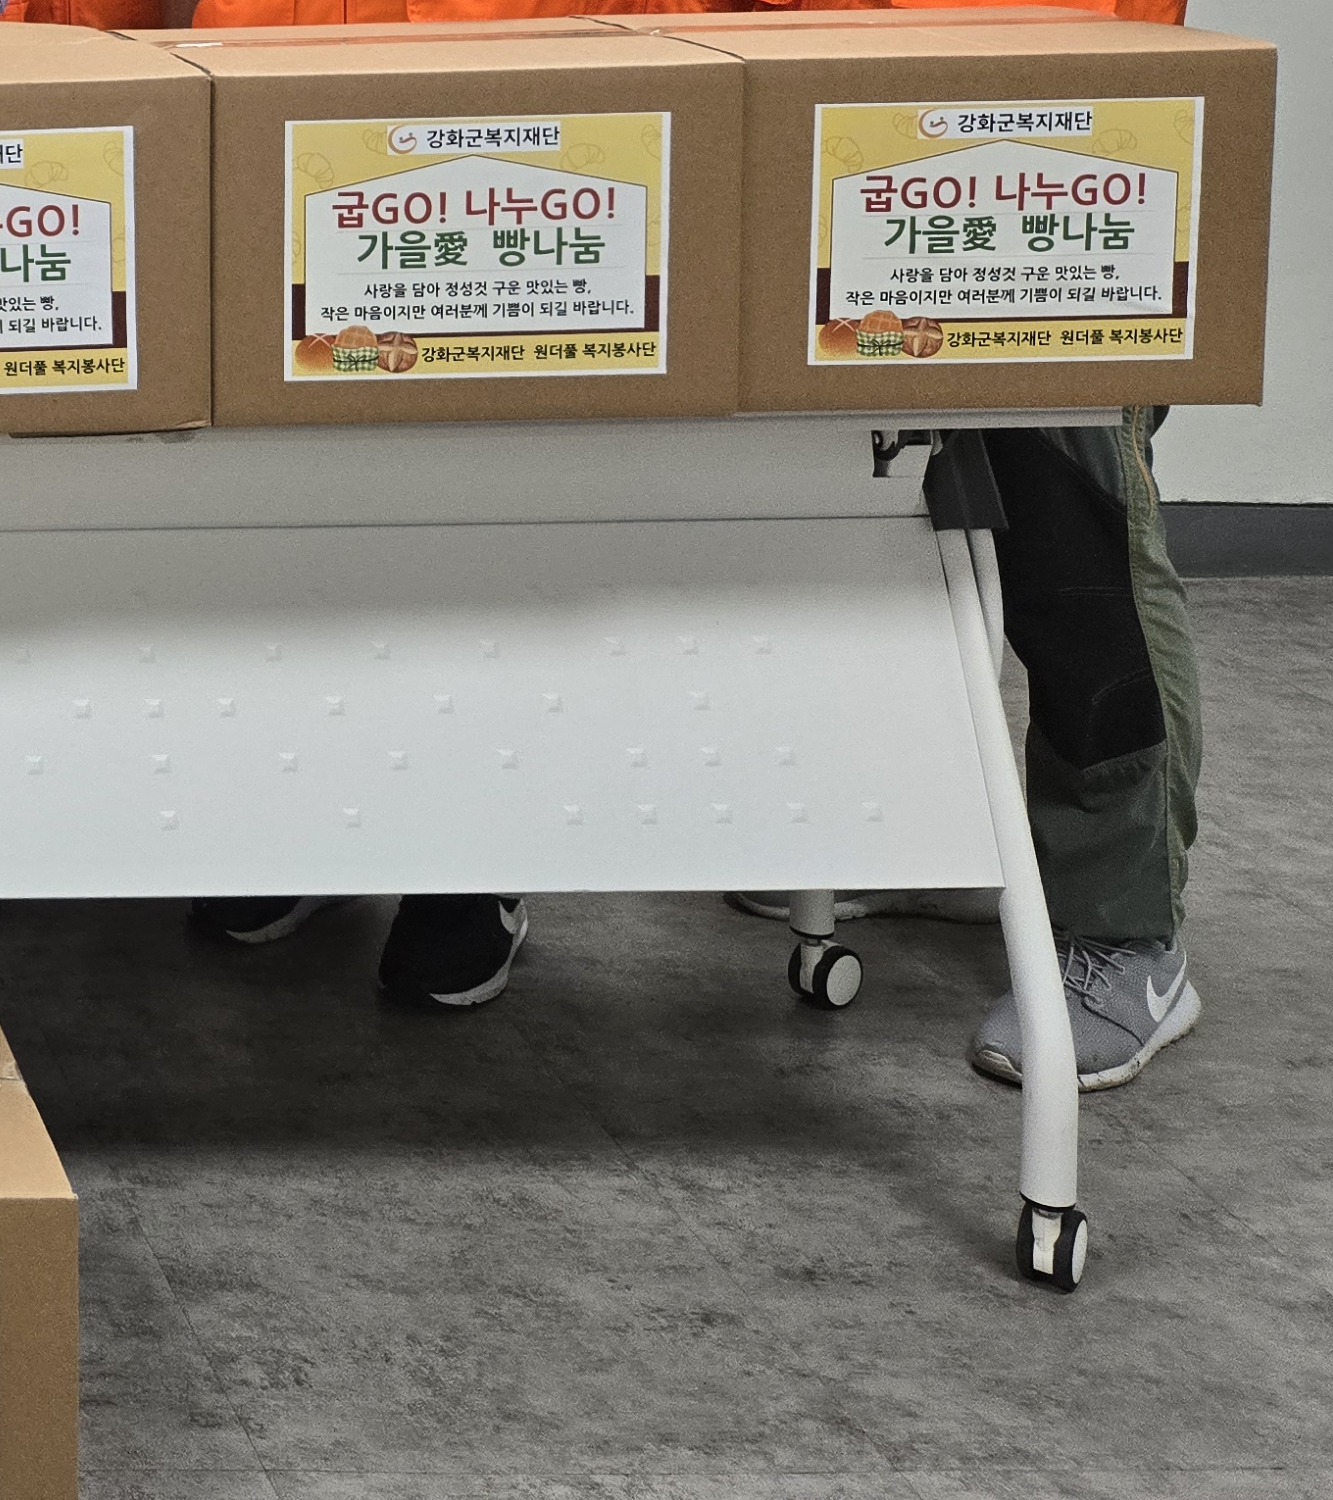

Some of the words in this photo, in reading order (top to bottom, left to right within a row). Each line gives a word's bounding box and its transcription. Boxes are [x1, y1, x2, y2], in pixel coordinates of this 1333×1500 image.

[958, 111, 1093, 132] 강화군복지재단
[427, 126, 560, 148] 강화군복지재단
[859, 174, 977, 212] 굽GO!
[994, 172, 1147, 210] 나누GO!
[331, 190, 447, 229] 굽GO!
[465, 186, 616, 225] 나누GO!
[883, 215, 998, 254] 가을愛
[1020, 213, 1136, 252] 빵나눔
[357, 230, 469, 270] 가을愛
[492, 227, 606, 267] 빵나눔
[364, 282, 406, 298] 사랑을
[412, 282, 439, 298] 담아
[491, 280, 521, 296] 구운
[526, 280, 568, 295] 맛있는
[947, 331, 1051, 349] 강화군복지재단
[1059, 330, 1105, 345] 원더풀
[1109, 328, 1183, 344] 복지봉사단
[421, 345, 525, 364] 강화군복지재단
[533, 344, 578, 360] 원더풀
[583, 342, 656, 359] 복지봉사단
[4, 361, 48, 377] 원더풀
[52, 358, 125, 375] 복지봉사단
